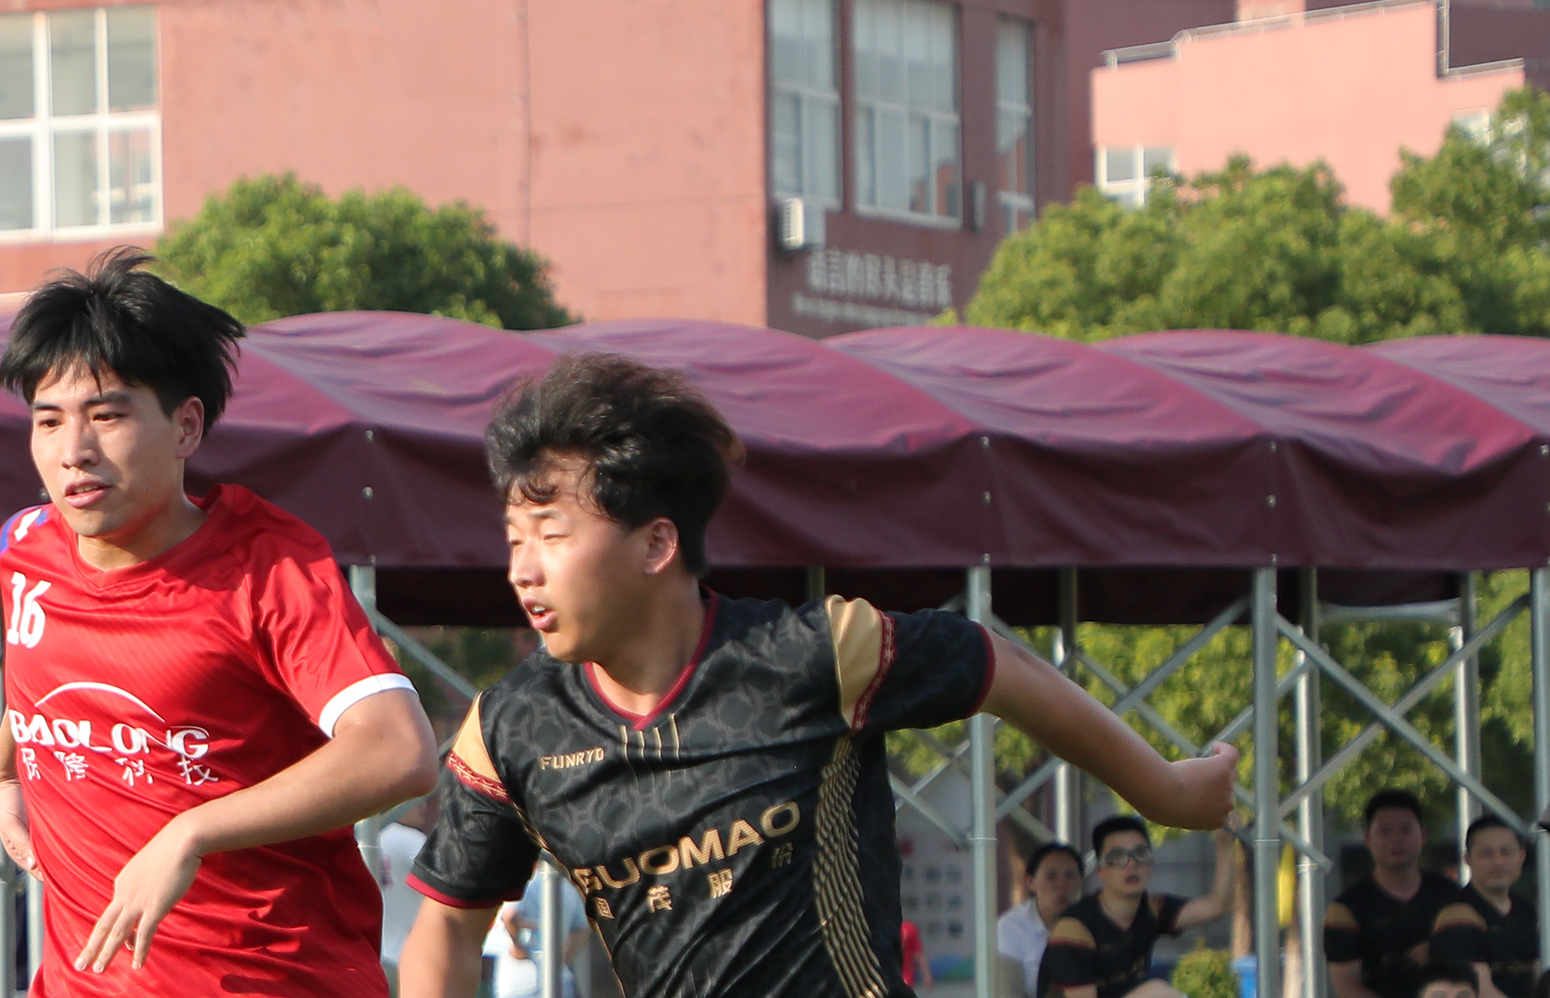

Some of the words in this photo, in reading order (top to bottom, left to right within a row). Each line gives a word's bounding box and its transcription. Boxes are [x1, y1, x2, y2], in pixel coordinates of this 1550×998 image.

[7, 571, 52, 648] 16
[9, 709, 210, 760] BAOLONG
[540, 747, 605, 770] FUNRYO
[572, 800, 801, 895] GUOMAO
